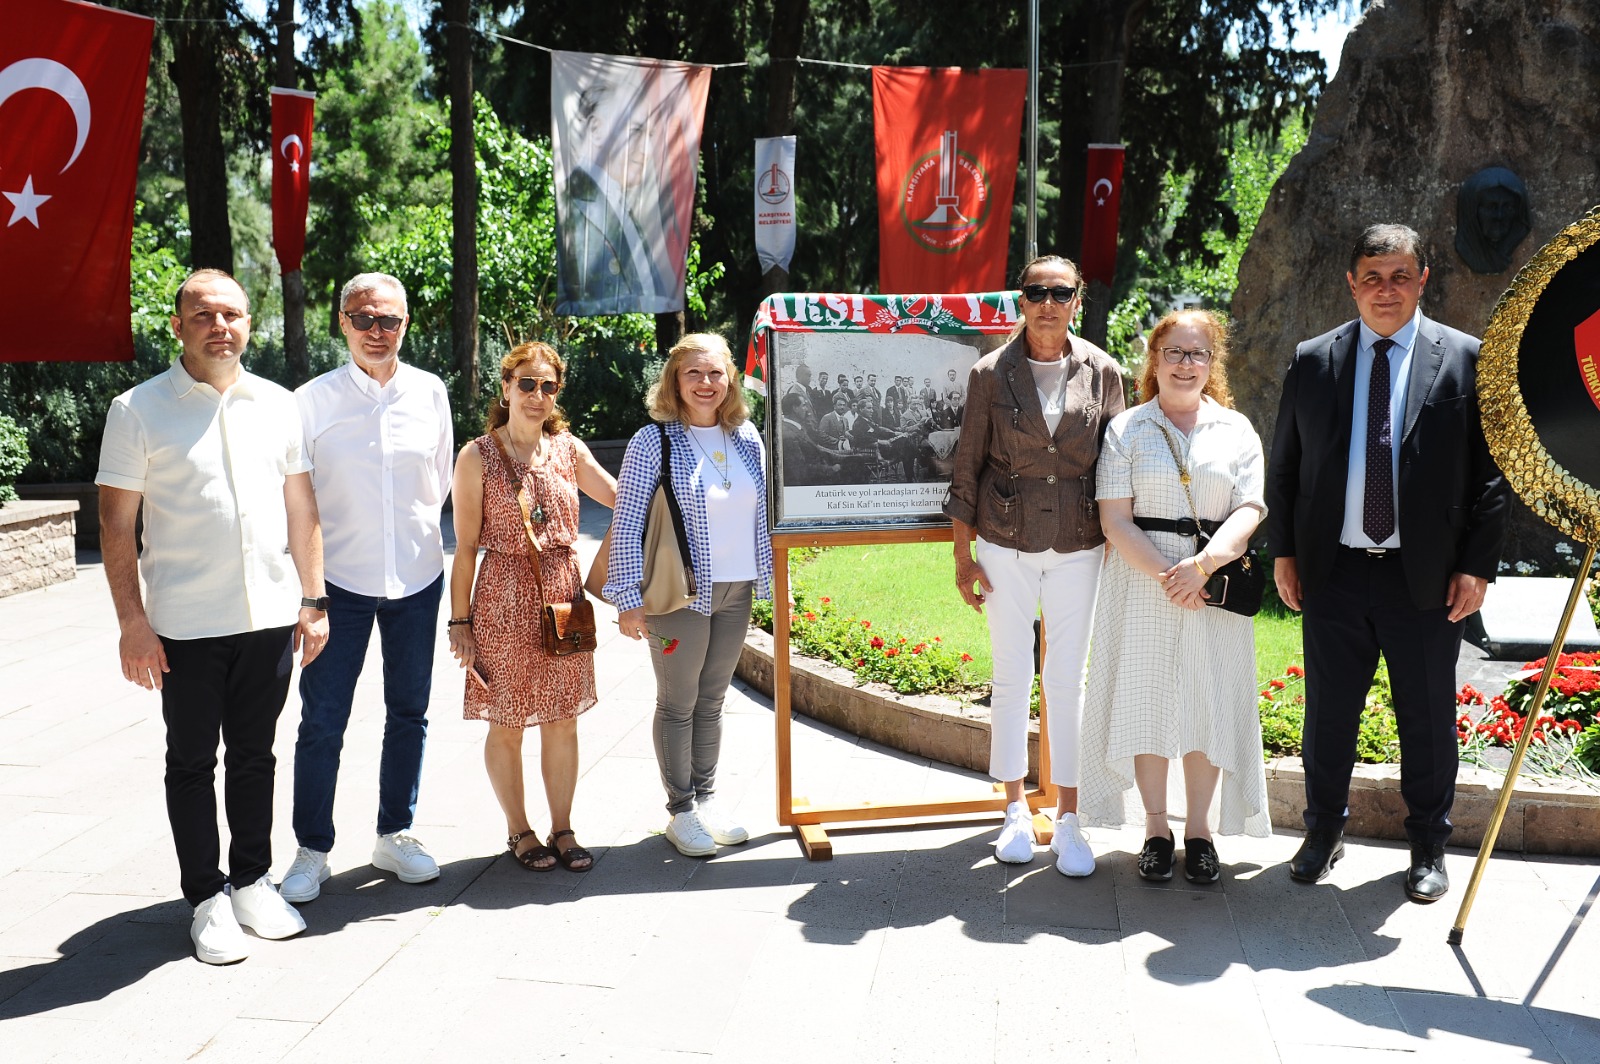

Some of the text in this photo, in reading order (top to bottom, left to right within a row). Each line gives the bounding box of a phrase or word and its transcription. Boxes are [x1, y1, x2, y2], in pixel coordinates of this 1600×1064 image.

[906, 159, 936, 203] KARŞIYAKA
[815, 487, 947, 499] Atatürk ve yol arkadaşları 24 Haz
[827, 501, 840, 509] Kaf
[842, 501, 855, 509] Sin
[882, 499, 909, 509] tenisçi
